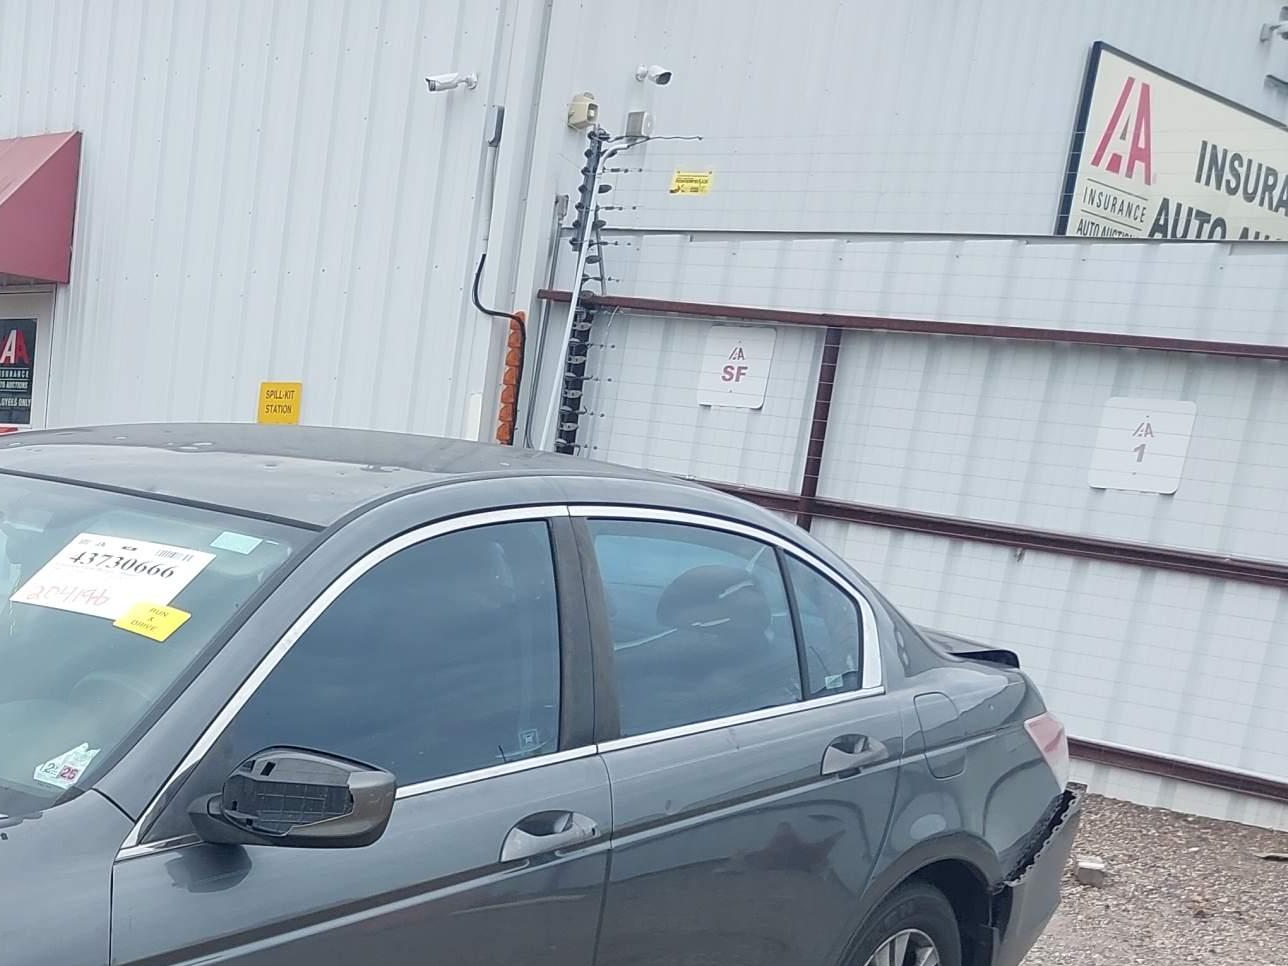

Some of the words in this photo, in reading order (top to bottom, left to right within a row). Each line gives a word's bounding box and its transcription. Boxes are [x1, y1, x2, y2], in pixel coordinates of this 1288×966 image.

[1083, 187, 1147, 223] INSURANCE
[721, 365, 749, 382] SF
[18, 398, 32, 407] ONLY
[265, 404, 292, 413] STATION
[1133, 443, 1146, 462] 1
[71, 551, 177, 579] 43730666
[149, 607, 169, 617] RUN
[130, 619, 158, 631] DRIVE
